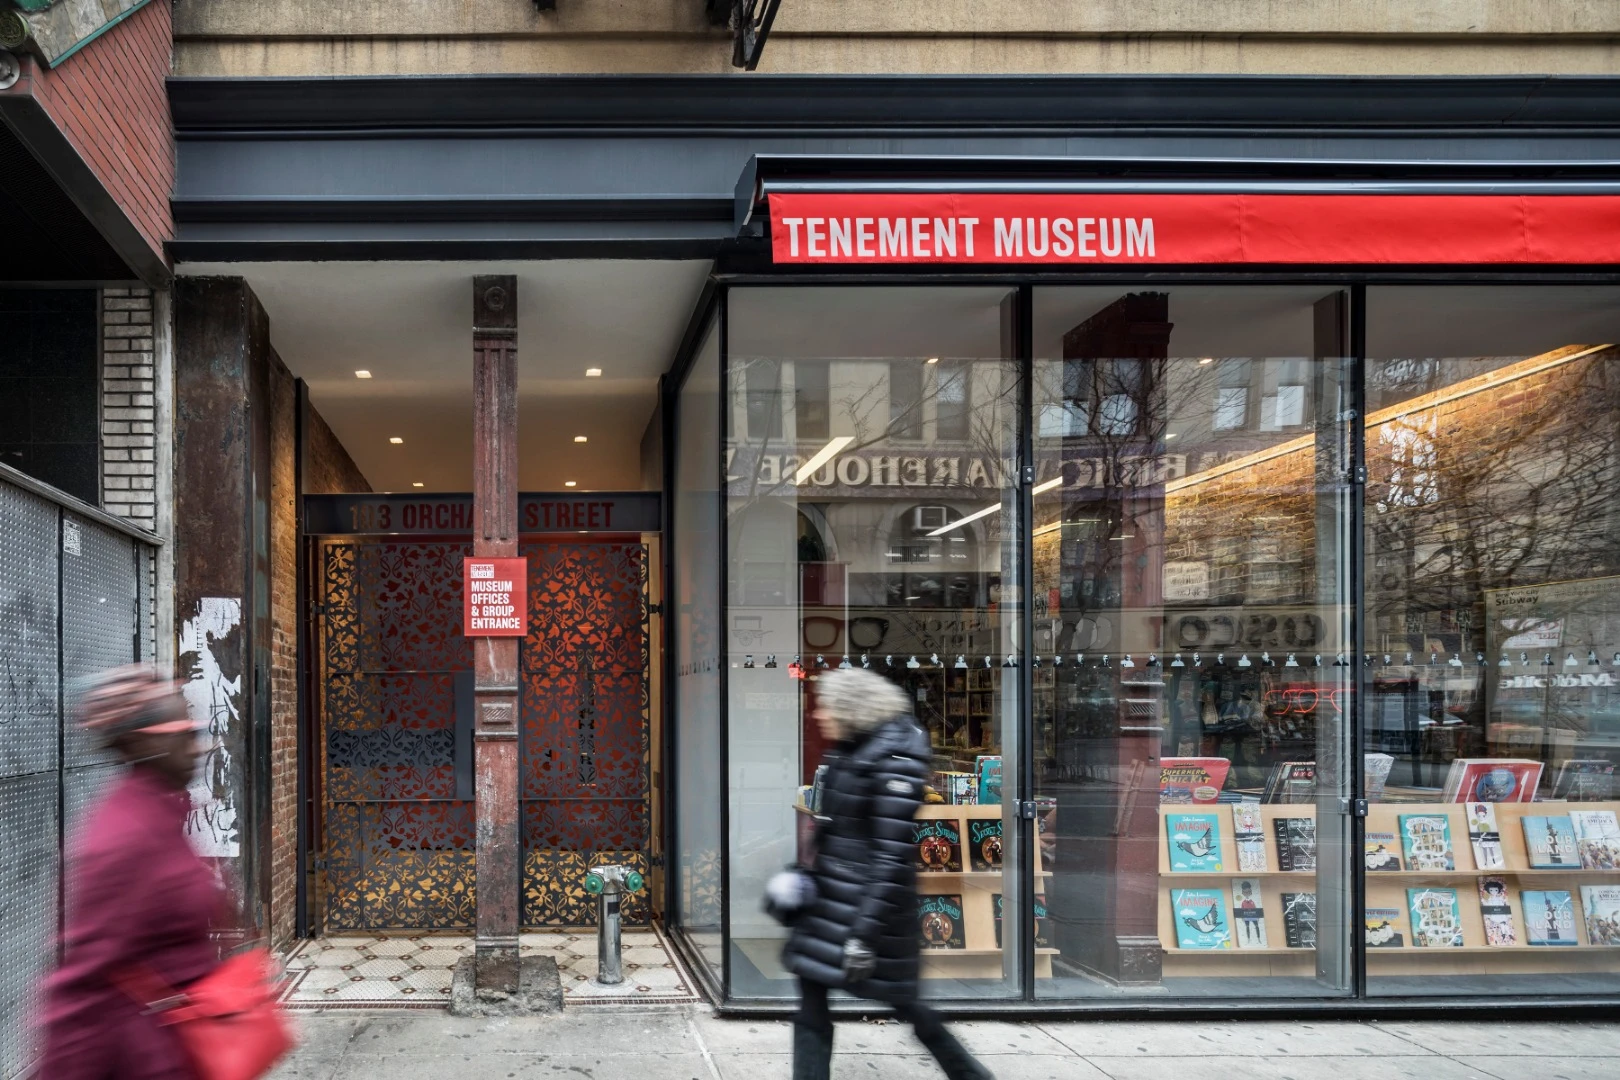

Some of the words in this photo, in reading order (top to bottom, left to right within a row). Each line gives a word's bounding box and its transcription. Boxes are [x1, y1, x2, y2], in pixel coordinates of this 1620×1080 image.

[782, 217, 979, 258] TENEMENT
[994, 217, 1156, 258] MUSEUM
[350, 503, 392, 530] 103
[402, 502, 475, 530] ORCHA
[524, 501, 614, 529] STREET
[471, 580, 513, 592] MUSEUM
[471, 593, 510, 605] OFFICES
[1495, 595, 1539, 607] Subway
[471, 605, 479, 617] &
[482, 605, 515, 617] GROUP
[471, 617, 521, 629] ENTRANCE
[1162, 768, 1207, 776] SUPERHERO
[1160, 775, 1190, 784] OMIC
[1191, 773, 1212, 784] KIT
[1174, 822, 1214, 832] IMAGINE
[1278, 819, 1289, 870] TENEMENT
[1179, 897, 1219, 908] IMAGINE
[1544, 911, 1573, 921] OUR
[1534, 920, 1573, 930] LAND
